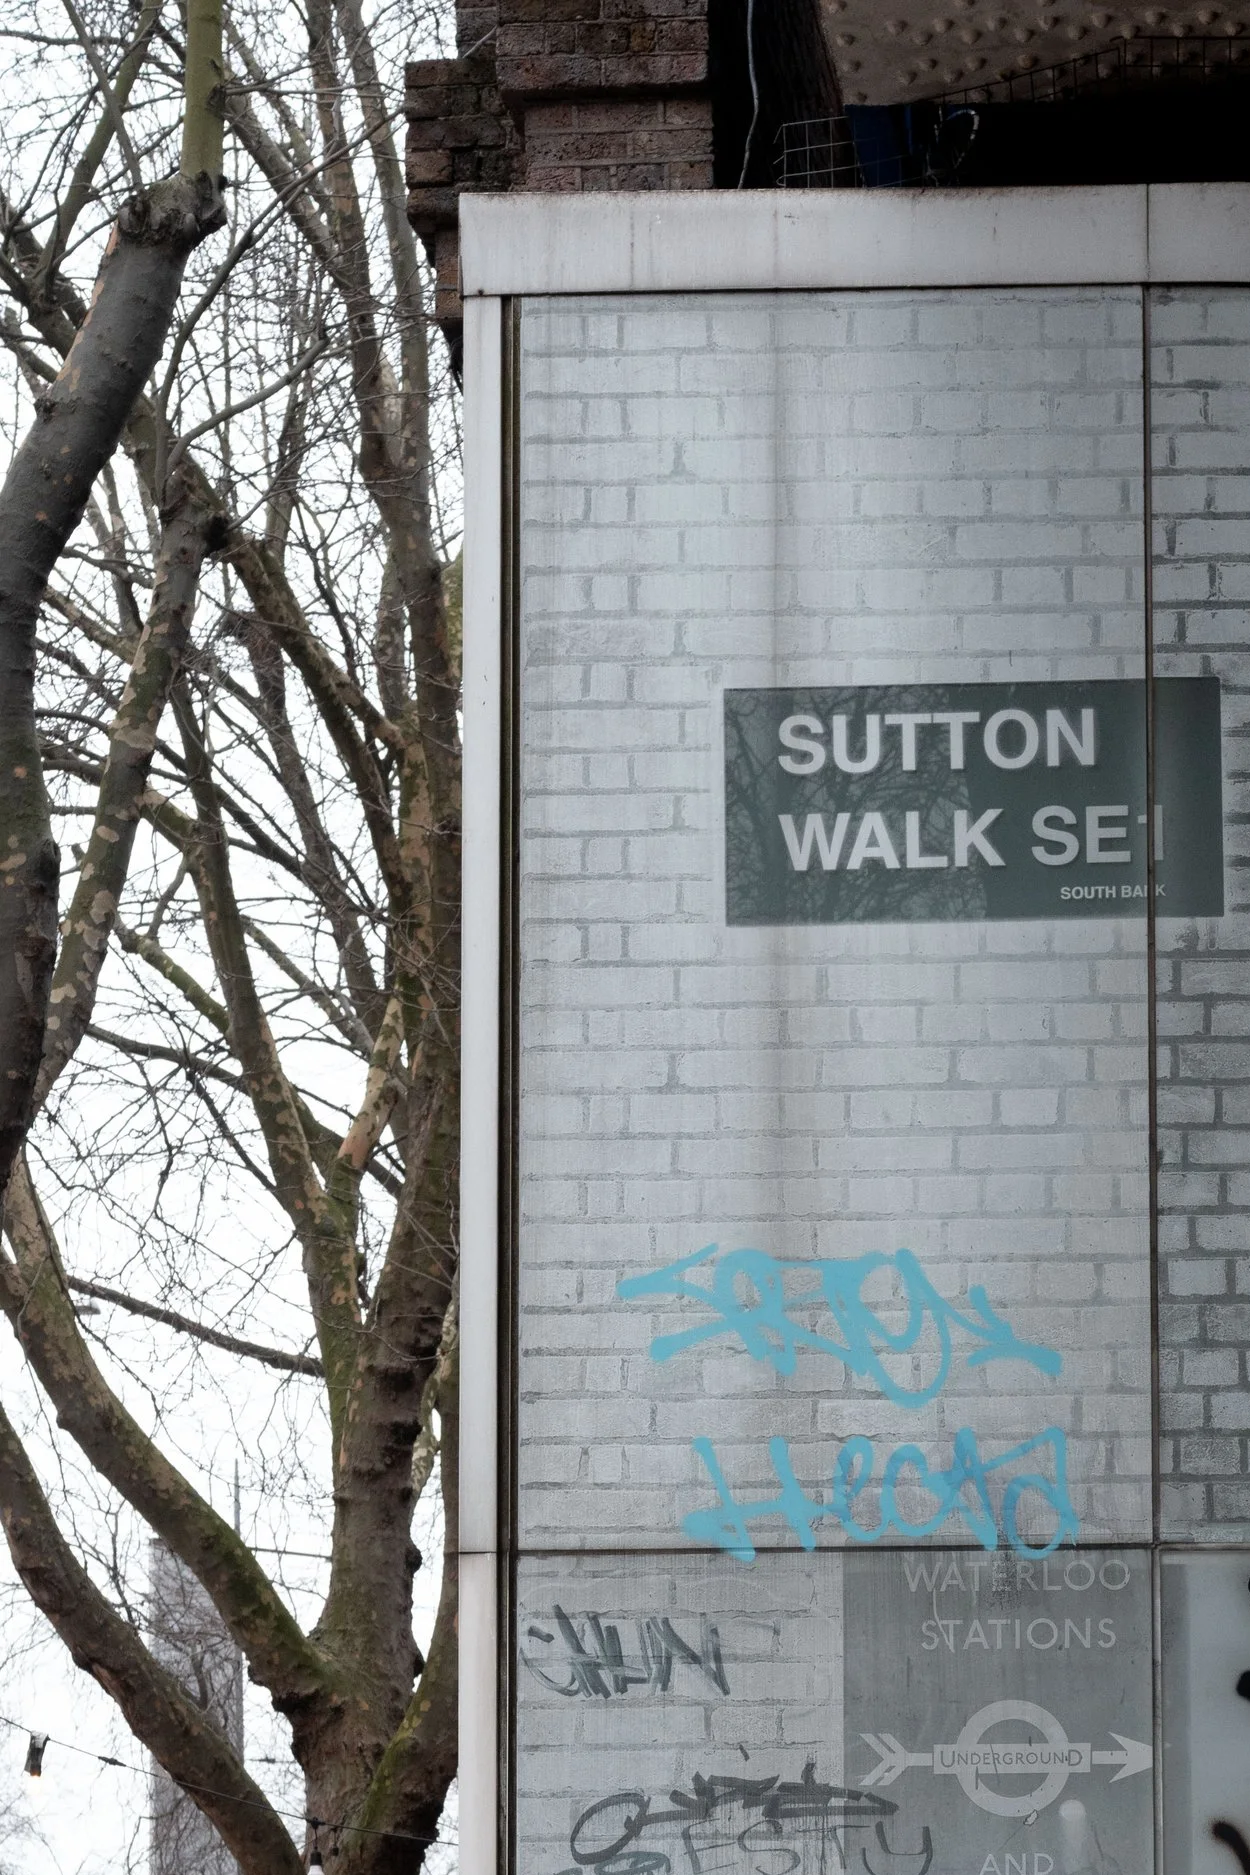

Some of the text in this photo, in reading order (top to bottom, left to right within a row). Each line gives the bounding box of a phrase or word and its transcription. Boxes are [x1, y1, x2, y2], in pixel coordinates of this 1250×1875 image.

[778, 708, 1095, 775] SUTTON
[778, 805, 1164, 872] WALK SE1
[1060, 885, 1116, 900] SOUTH
[903, 1559, 1131, 1592] WATERLOO
[921, 1617, 1117, 1650] STATIONS
[940, 1749, 1083, 1767] UNDERGROUND
[979, 1852, 1054, 1875] AND
